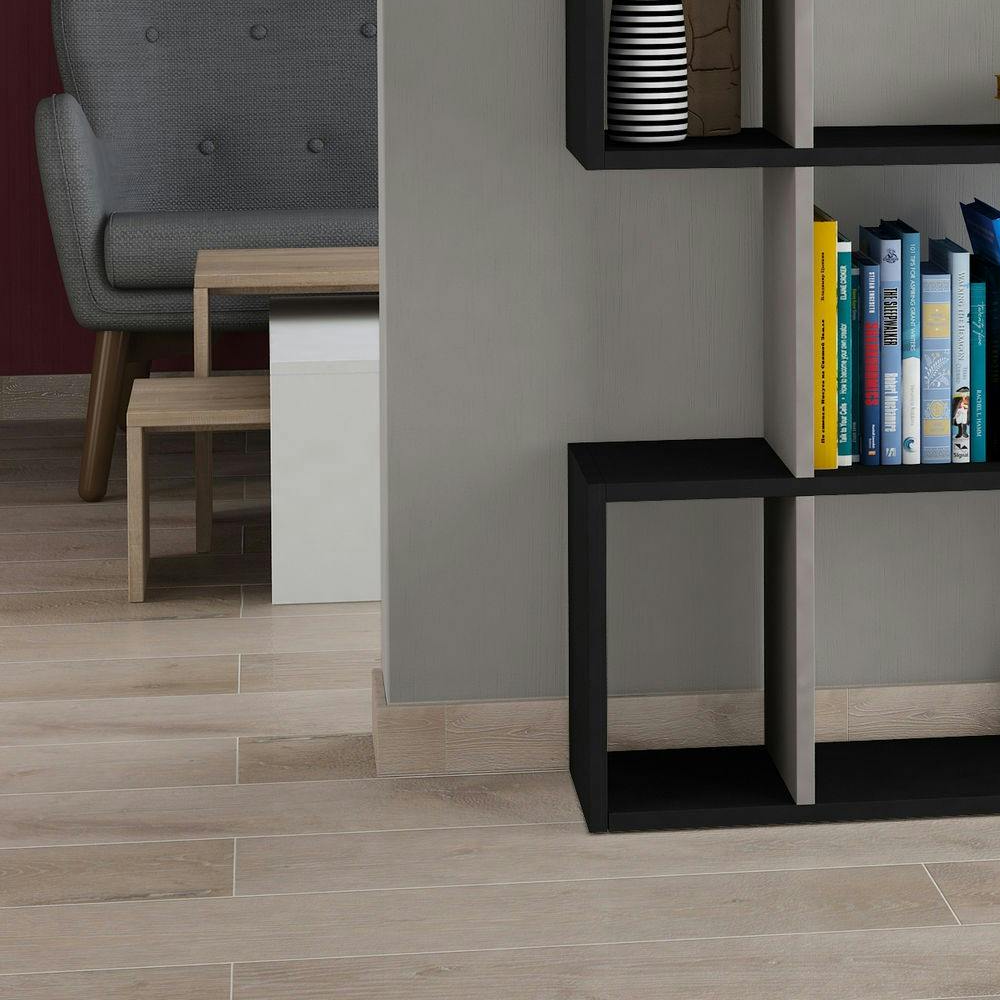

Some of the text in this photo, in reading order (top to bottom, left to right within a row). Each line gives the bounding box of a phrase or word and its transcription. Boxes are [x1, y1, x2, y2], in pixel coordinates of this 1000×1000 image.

[957, 272, 966, 305] WALKING
[883, 287, 898, 346] THE SLEEPWALKER
[958, 325, 966, 361] HEXAGON
[840, 349, 848, 360] your
[884, 372, 898, 394] Robert
[839, 402, 848, 416] Cells
[839, 415, 847, 427] Your
[839, 432, 848, 444] Talk
